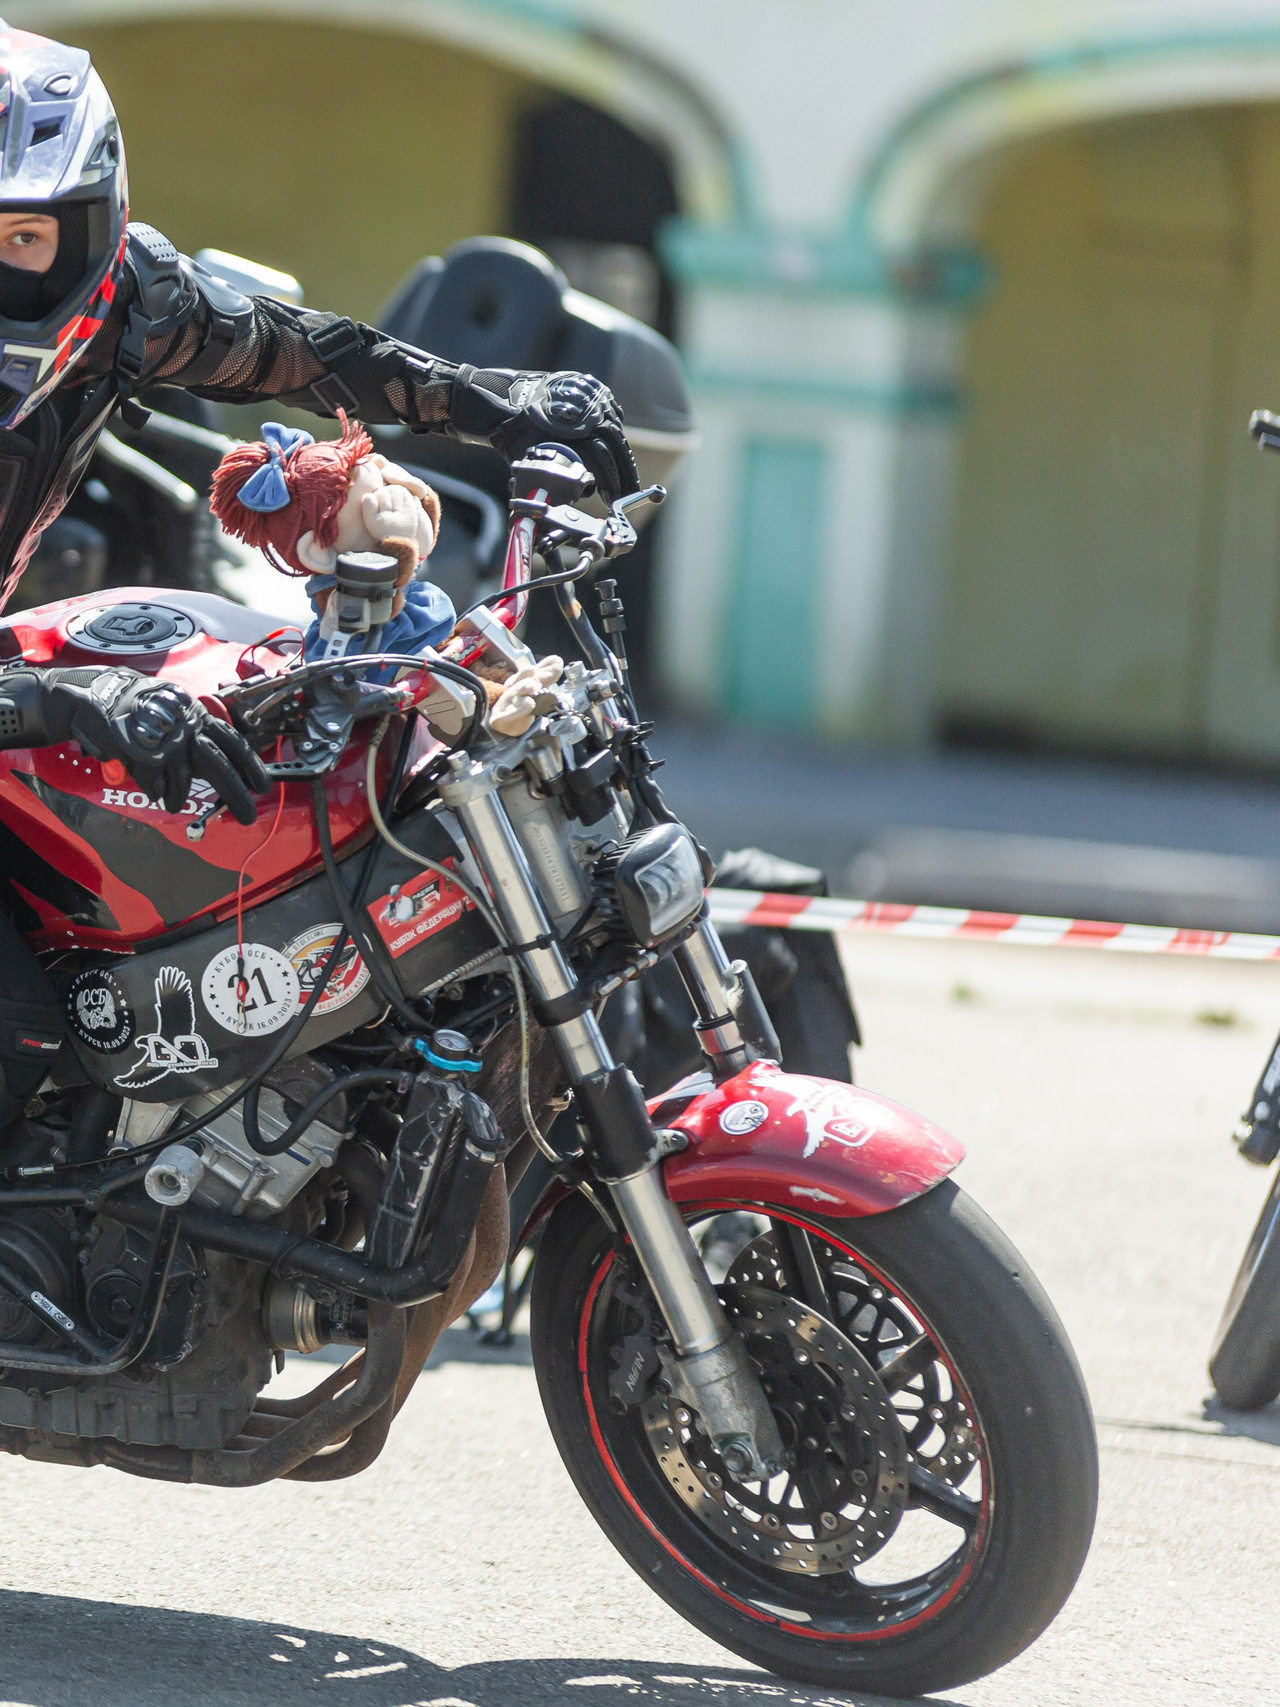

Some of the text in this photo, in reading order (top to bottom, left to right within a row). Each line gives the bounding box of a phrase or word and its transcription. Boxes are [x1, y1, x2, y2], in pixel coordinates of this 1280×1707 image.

[389, 929, 417, 951] КУБОК
[247, 949, 267, 960] ОСБ
[99, 969, 114, 984] ОСБ
[83, 988, 106, 1005] ОСБ
[227, 967, 277, 1014] 21
[257, 997, 293, 1030] 16.09.2023
[78, 1026, 131, 1049] КУРСК 16.09.2023
